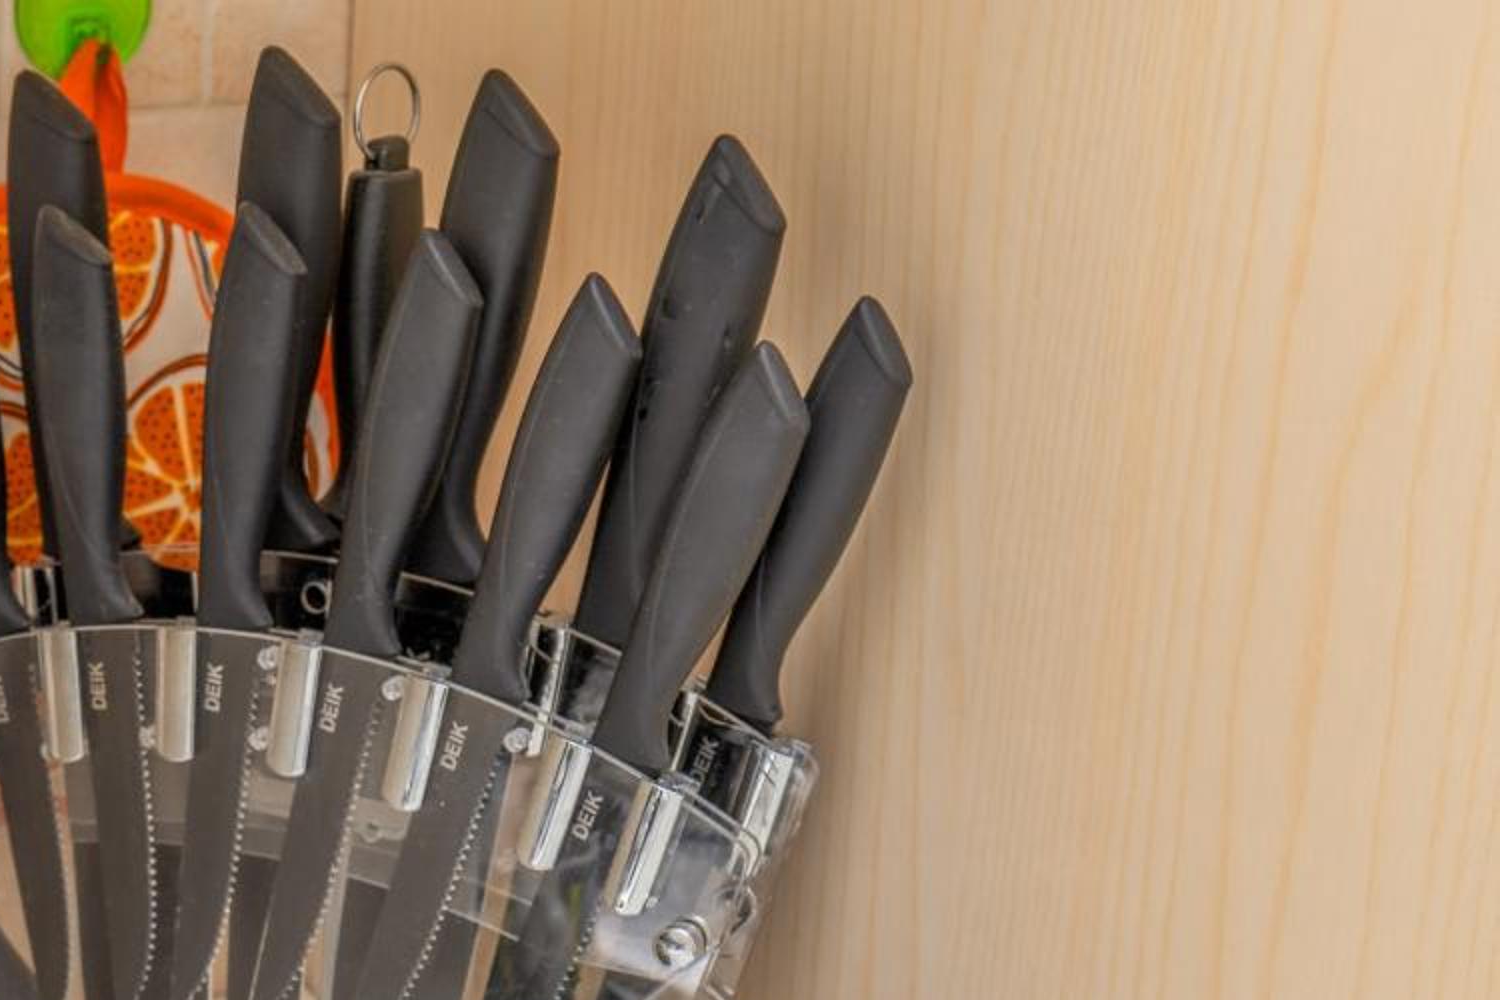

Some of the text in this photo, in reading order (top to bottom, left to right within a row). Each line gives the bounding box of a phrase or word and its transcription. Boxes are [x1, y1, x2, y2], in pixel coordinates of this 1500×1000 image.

[87, 662, 107, 710] DEIK
[204, 663, 224, 712] DEIK
[318, 682, 344, 733] DEIK
[440, 720, 469, 771] DEIK
[572, 790, 604, 840] DEIK
